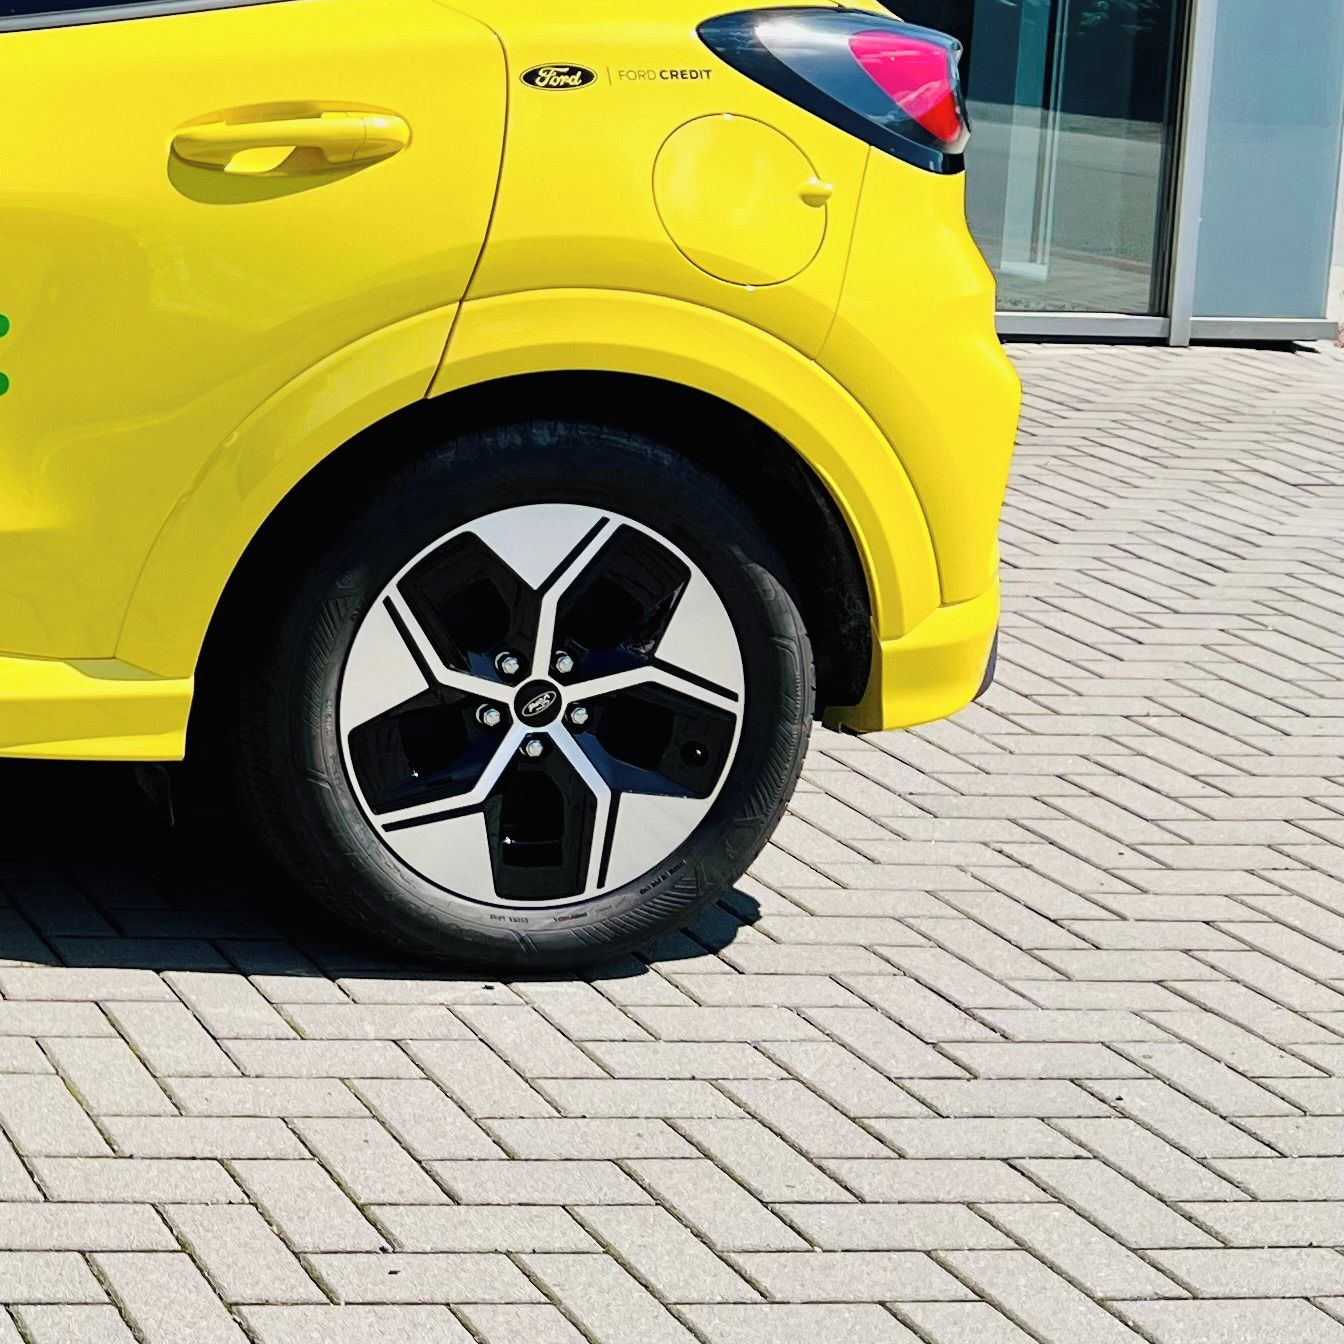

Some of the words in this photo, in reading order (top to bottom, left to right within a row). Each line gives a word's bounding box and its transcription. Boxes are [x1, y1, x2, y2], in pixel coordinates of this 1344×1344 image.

[534, 67, 583, 87] Ford
[618, 69, 657, 81] FORD
[659, 69, 713, 81] CREDIT
